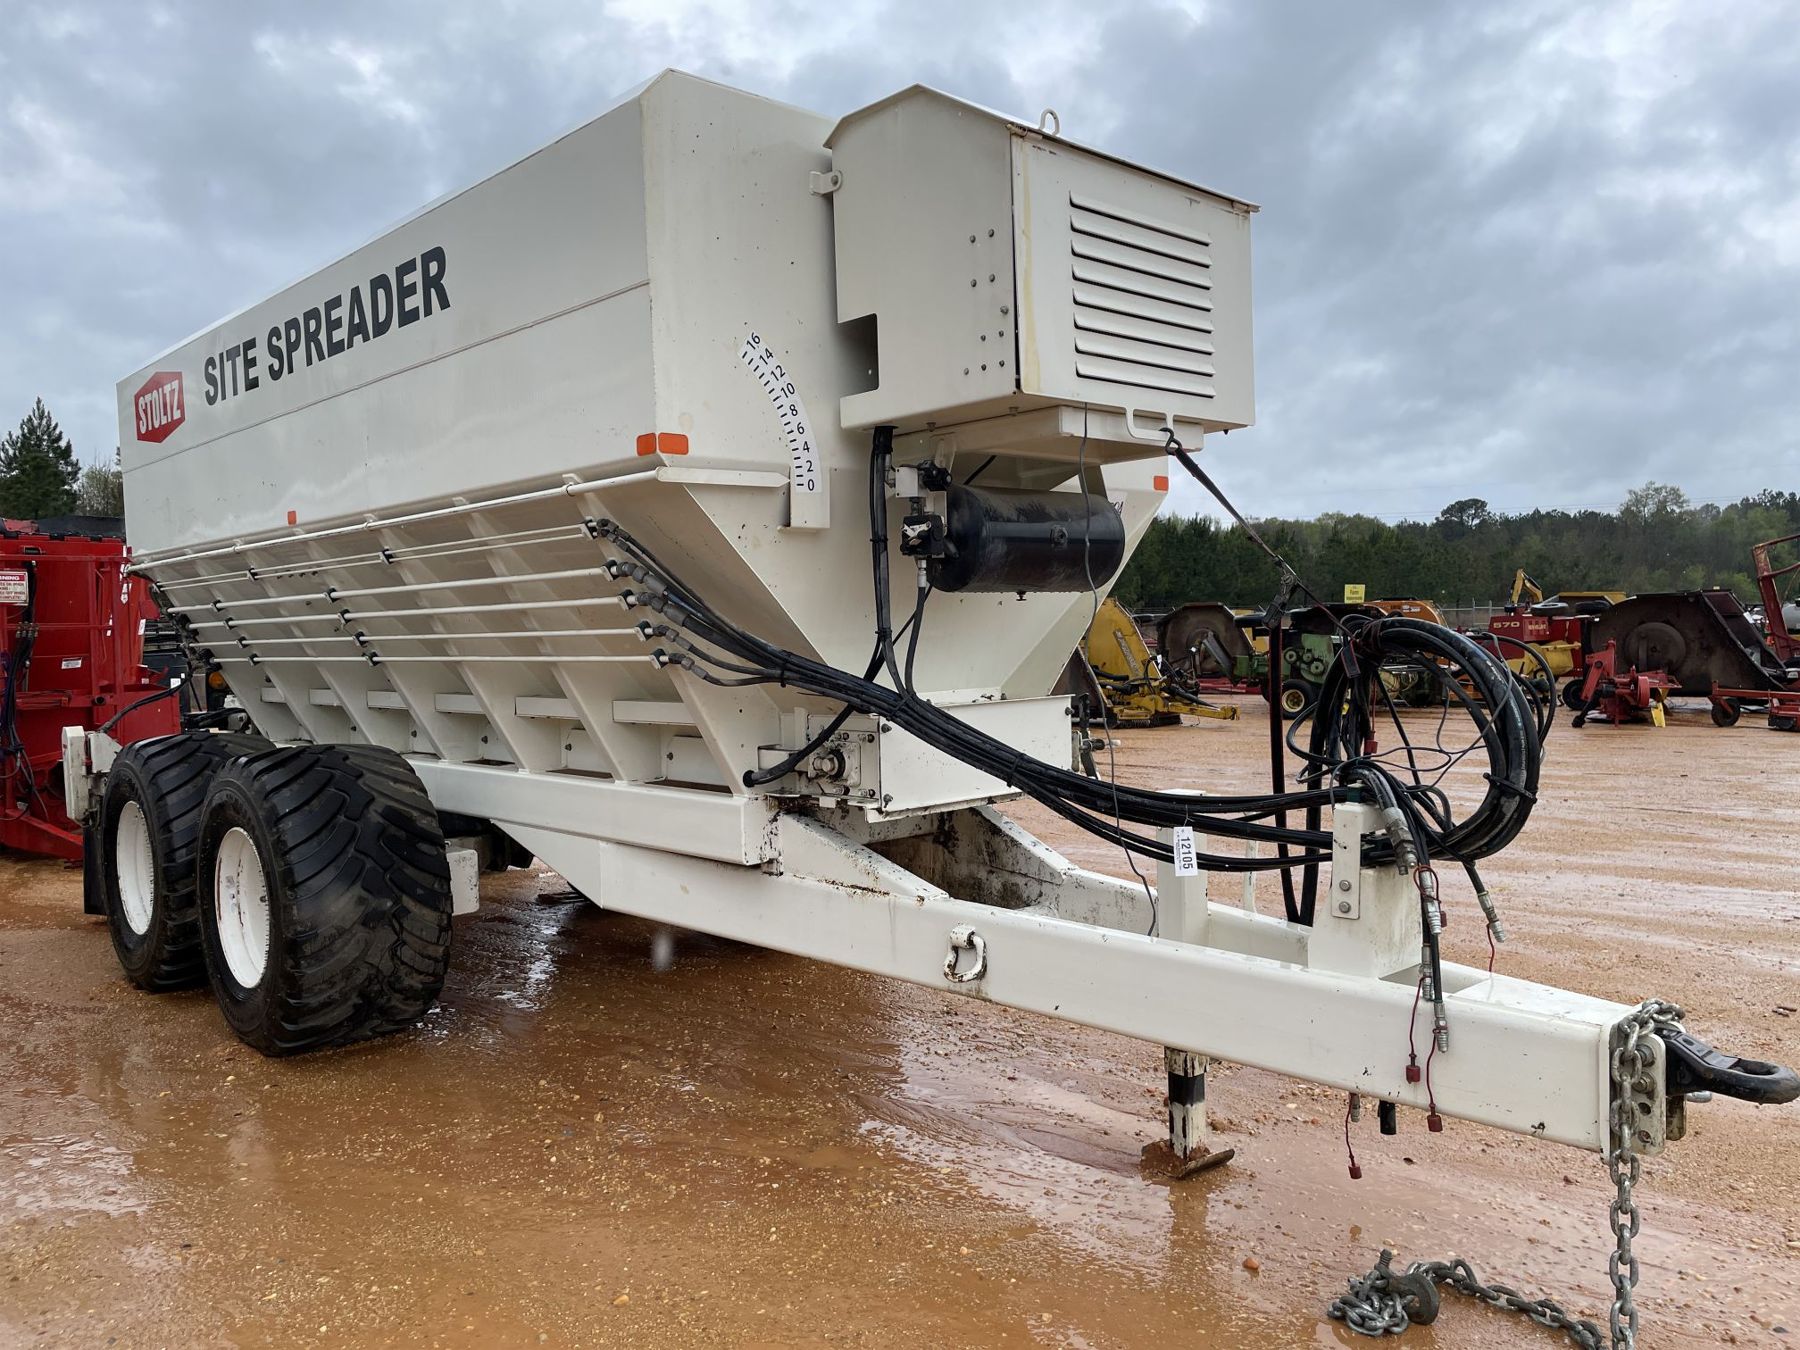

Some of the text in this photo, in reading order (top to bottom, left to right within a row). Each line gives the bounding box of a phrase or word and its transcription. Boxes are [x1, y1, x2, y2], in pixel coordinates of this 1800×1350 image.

[203, 245, 451, 406] SITE SPREADER
[746, 332, 761, 350] 16
[759, 347, 774, 365] 14
[770, 364, 786, 381] 12
[780, 382, 795, 398] 10
[138, 379, 182, 434] STOLTZ
[789, 404, 798, 417] 8
[796, 422, 805, 435] 6
[802, 441, 810, 453] 4
[806, 460, 814, 473] 2
[807, 479, 815, 491] 0
[1493, 621, 1520, 629] 570
[1181, 836, 1194, 870] 12105
